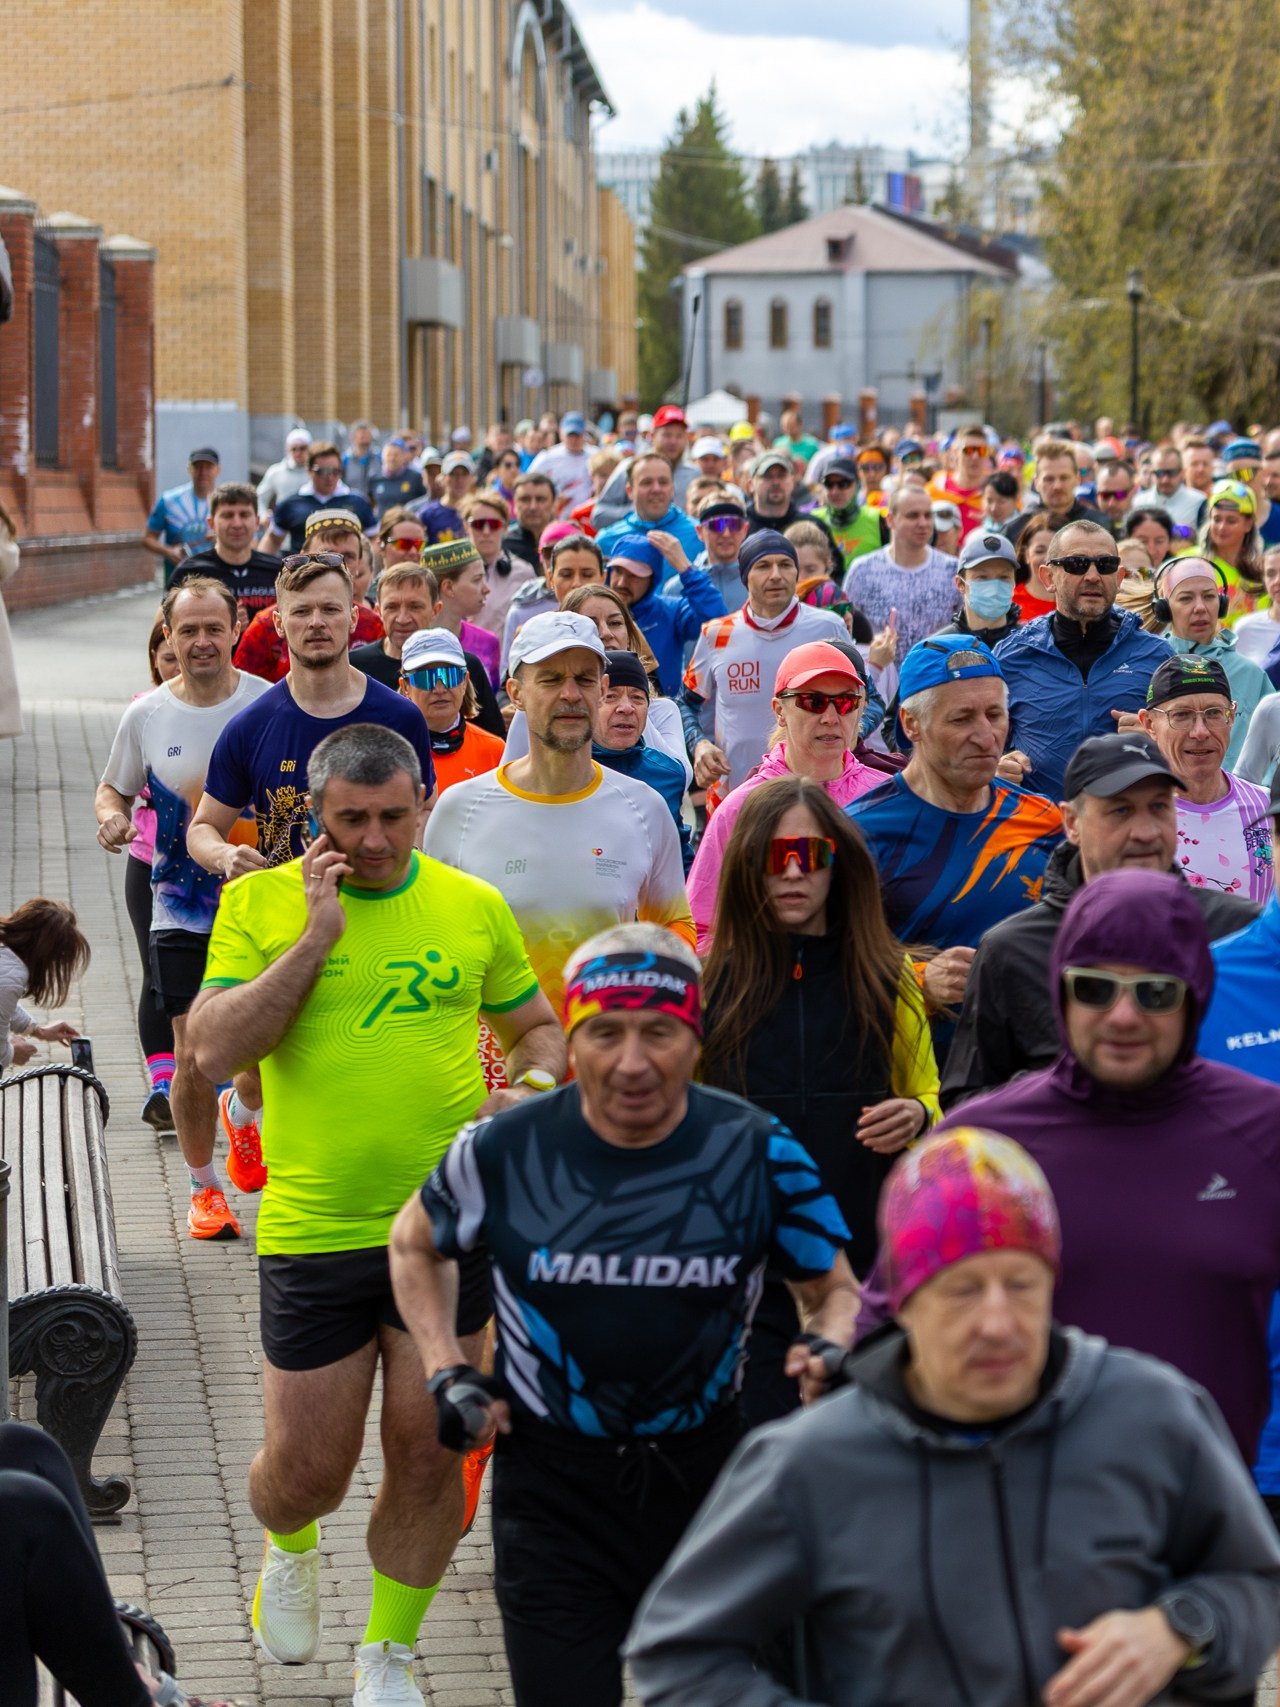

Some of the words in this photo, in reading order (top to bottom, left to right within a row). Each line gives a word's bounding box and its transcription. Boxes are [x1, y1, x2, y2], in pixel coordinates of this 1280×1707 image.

[727, 661, 759, 679] ODI
[729, 677, 760, 692] RUN
[167, 745, 182, 757] GRi
[280, 759, 297, 772] GRi
[504, 858, 527, 875] GRi
[583, 970, 687, 996] MALIDAK
[528, 1247, 743, 1289] MALIDAK
